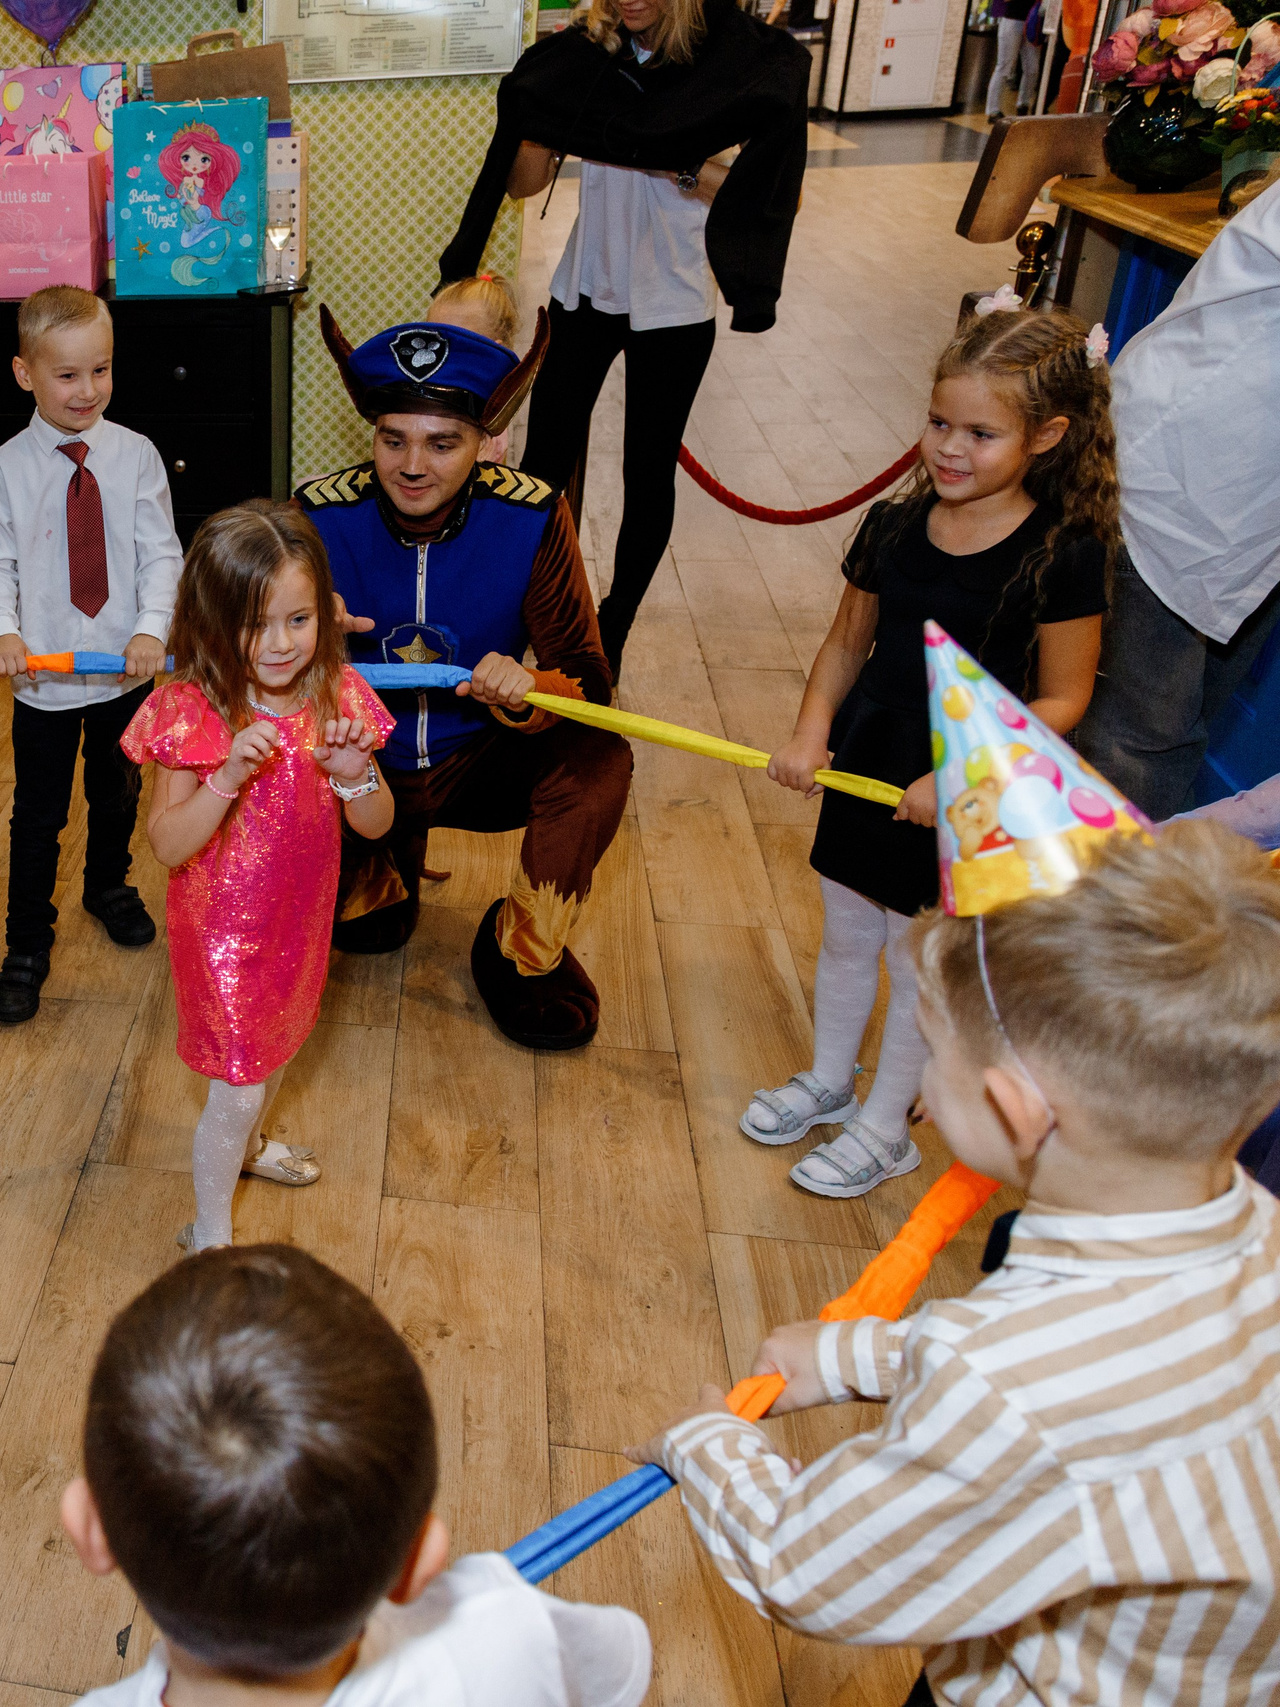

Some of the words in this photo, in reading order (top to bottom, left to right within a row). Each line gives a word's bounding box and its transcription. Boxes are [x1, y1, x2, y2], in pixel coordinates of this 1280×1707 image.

[0, 189, 27, 204] Little
[31, 190, 52, 203] star
[142, 205, 179, 229] Magic
